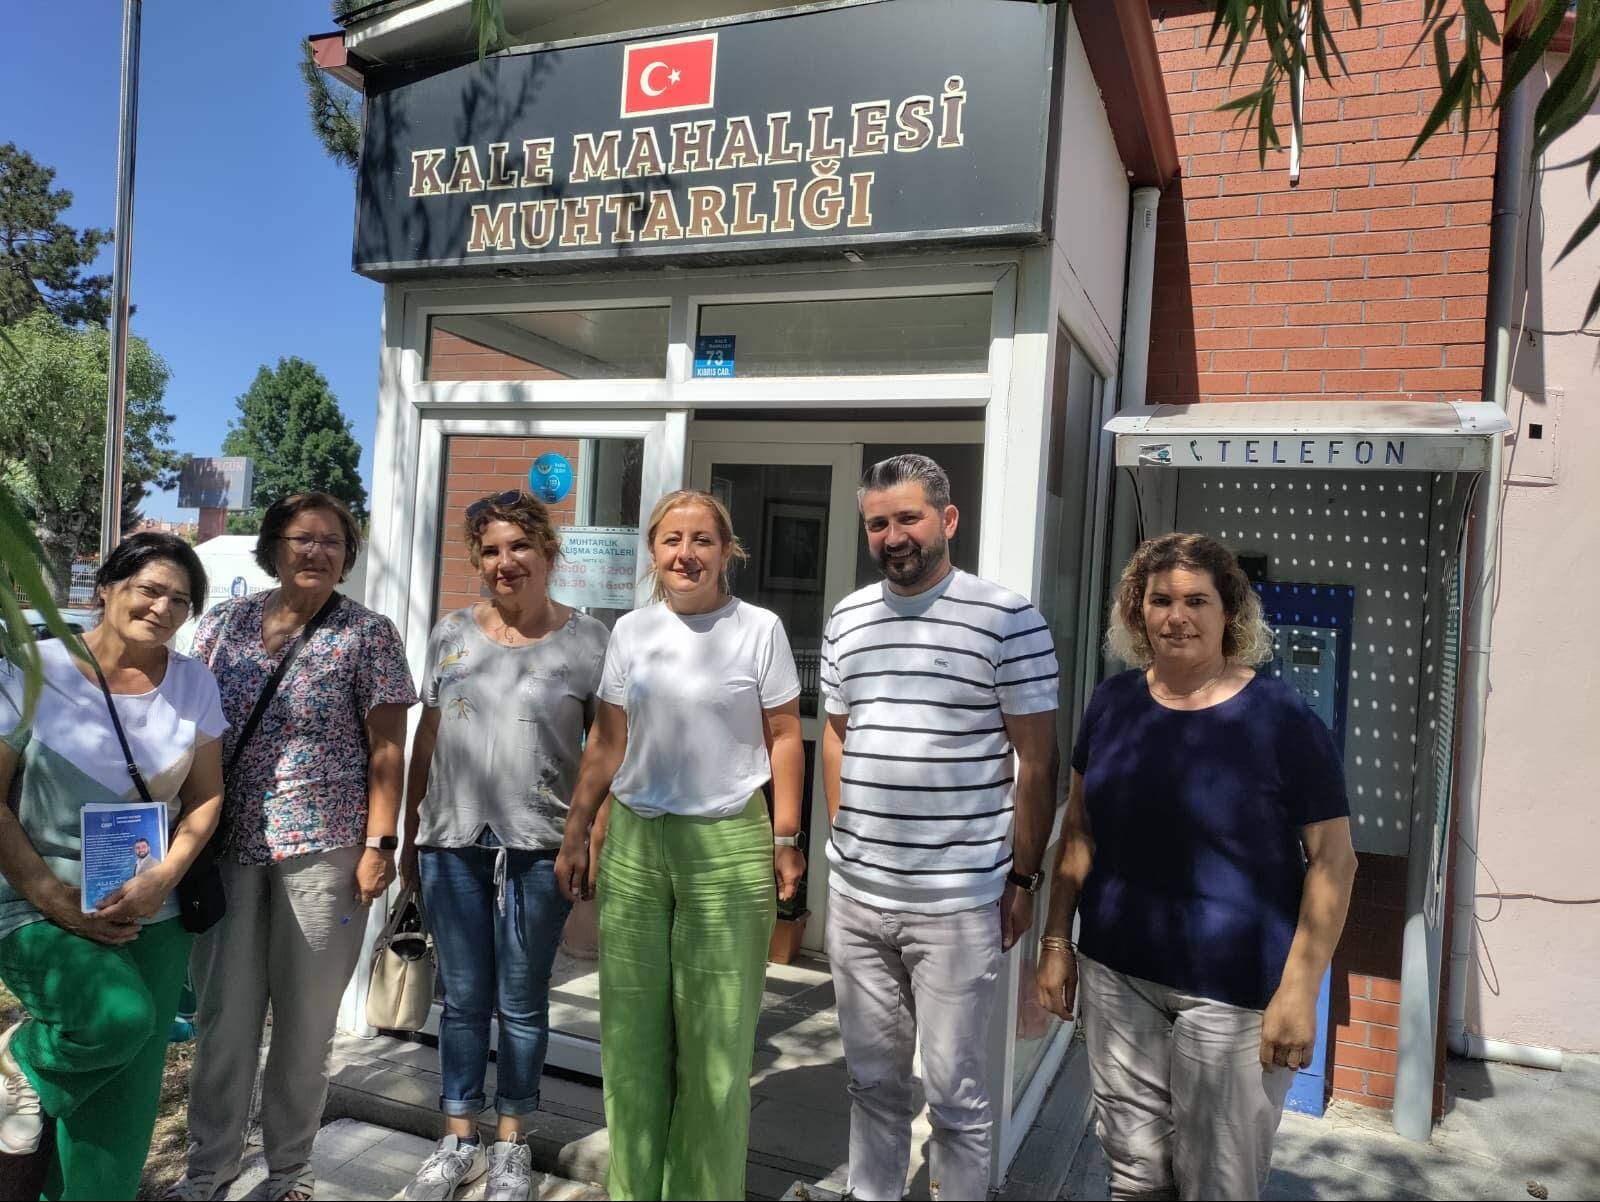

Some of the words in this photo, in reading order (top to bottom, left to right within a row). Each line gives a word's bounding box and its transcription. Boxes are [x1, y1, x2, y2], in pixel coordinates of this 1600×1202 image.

[409, 136, 555, 198] KALE
[569, 75, 967, 184] MAHALLESİ
[466, 158, 875, 253] MUHTARLIĞI
[706, 350, 724, 366] 73
[1217, 440, 1405, 465] TELEFON
[560, 546, 590, 555] ALIŞMA
[592, 548, 634, 556] SAATLERİ
[569, 538, 618, 547] MUHTARLIK
